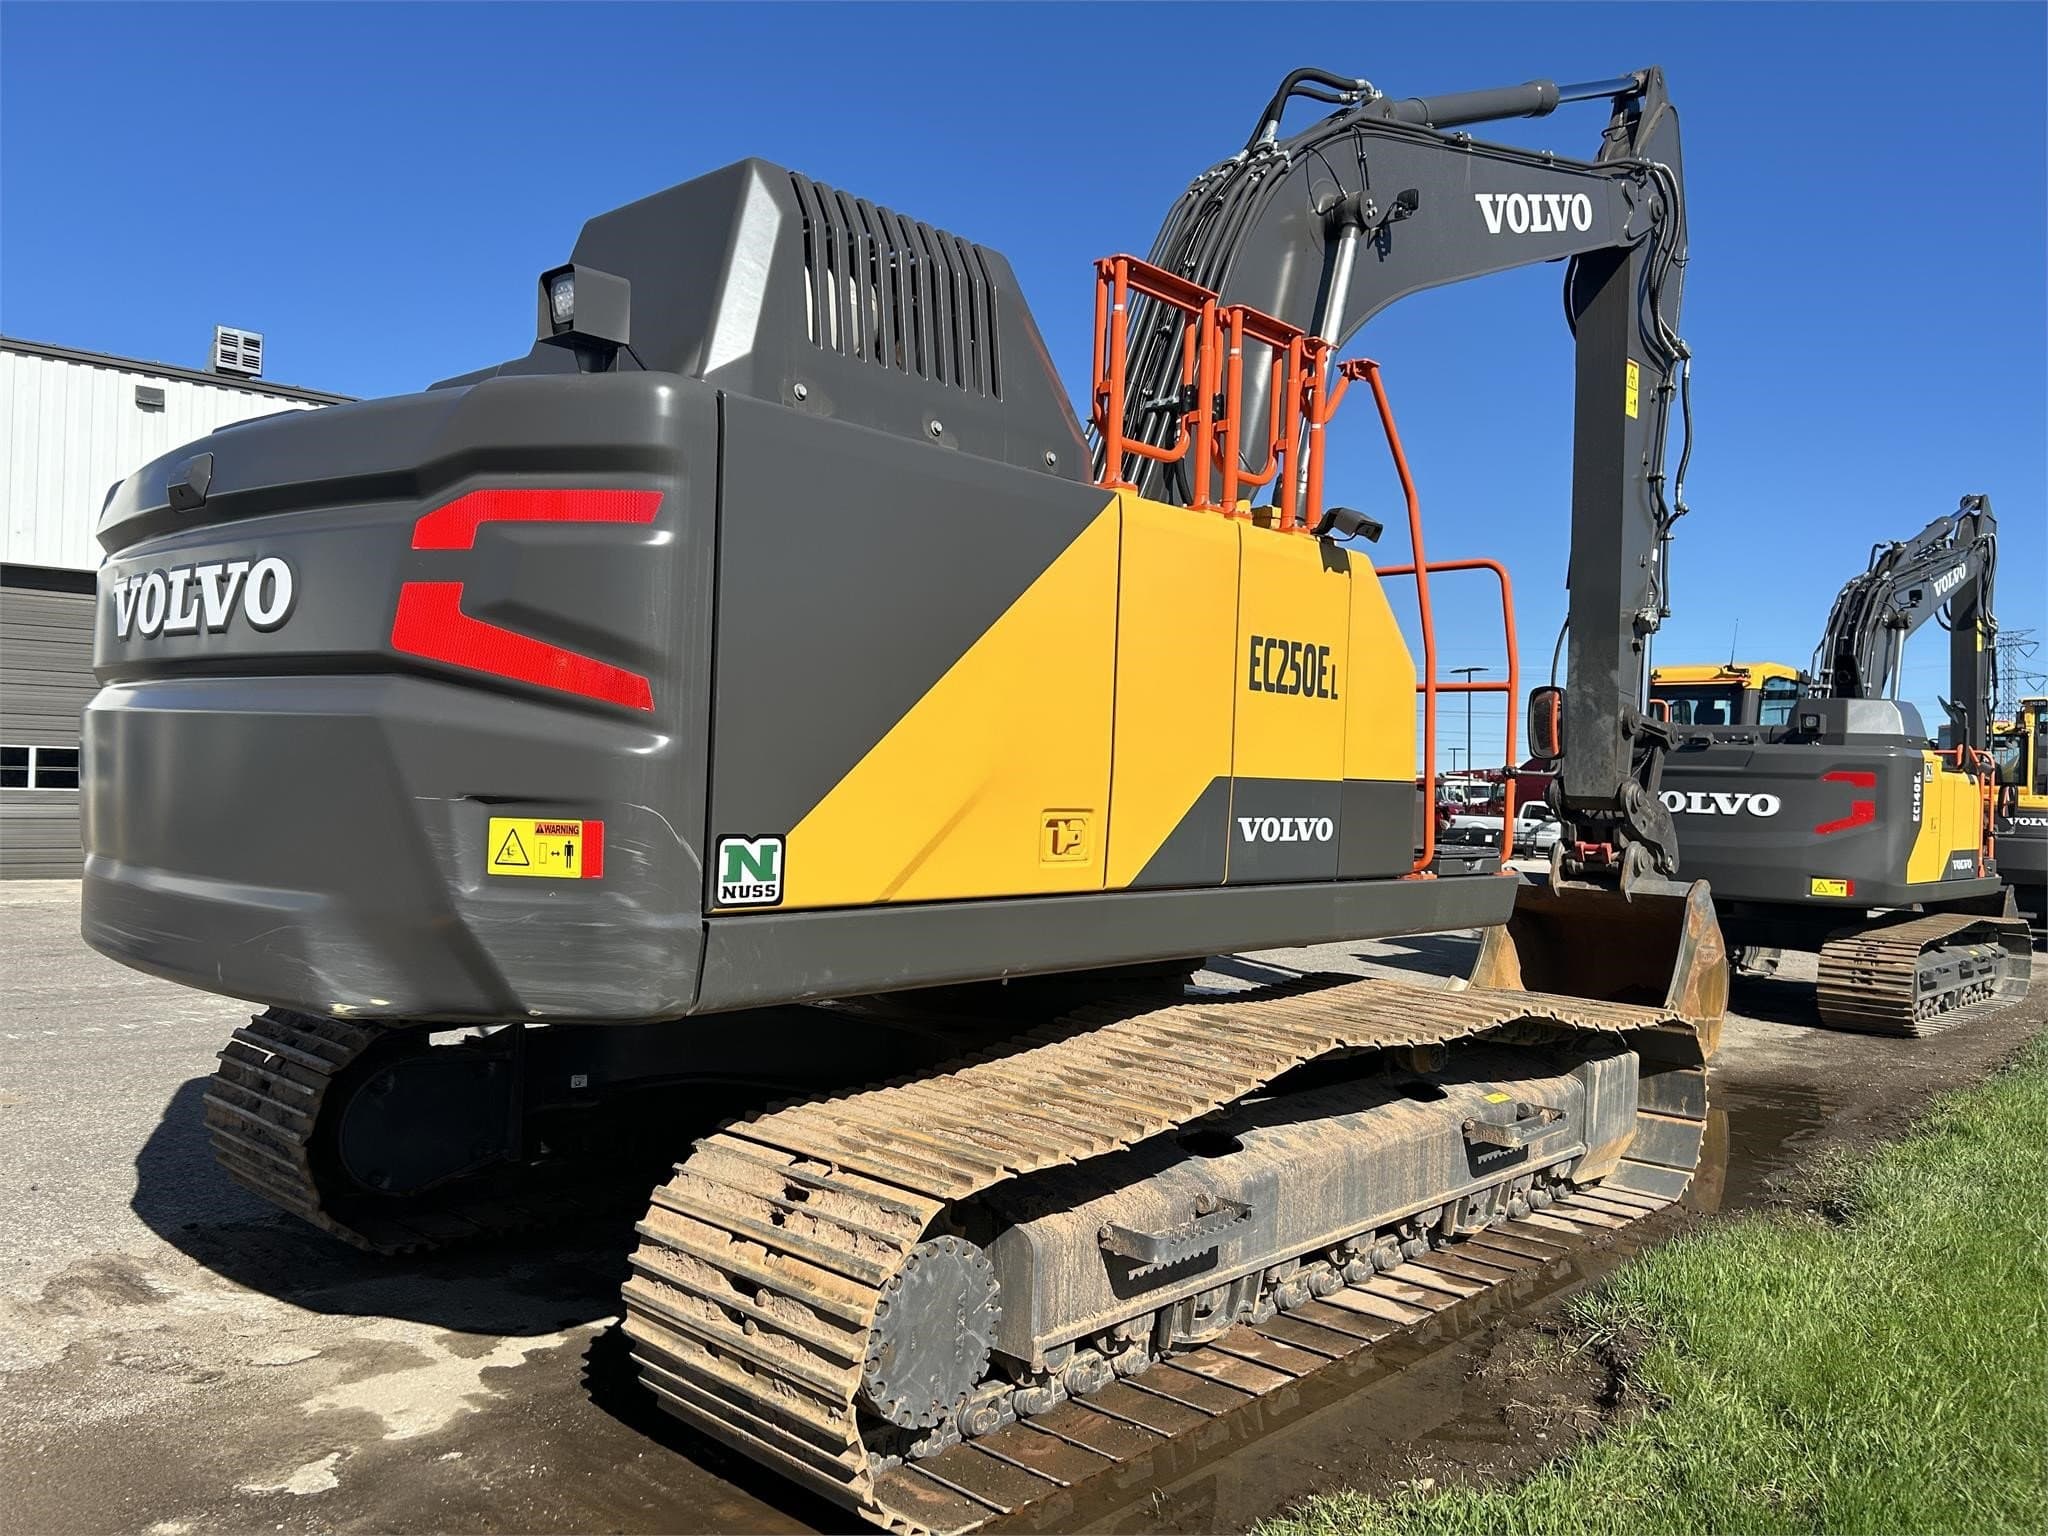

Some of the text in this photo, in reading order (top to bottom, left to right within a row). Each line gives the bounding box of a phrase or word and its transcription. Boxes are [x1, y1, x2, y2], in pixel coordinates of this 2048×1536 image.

[1475, 193, 1593, 234] VOLVO
[1933, 563, 1966, 597] VOLVO
[113, 557, 294, 638] VOLVO
[1658, 790, 1781, 817] OLVO
[544, 824, 580, 835] WARNING
[1238, 817, 1334, 842] VOLVO
[723, 844, 778, 883] N
[722, 884, 776, 899] NUSS
